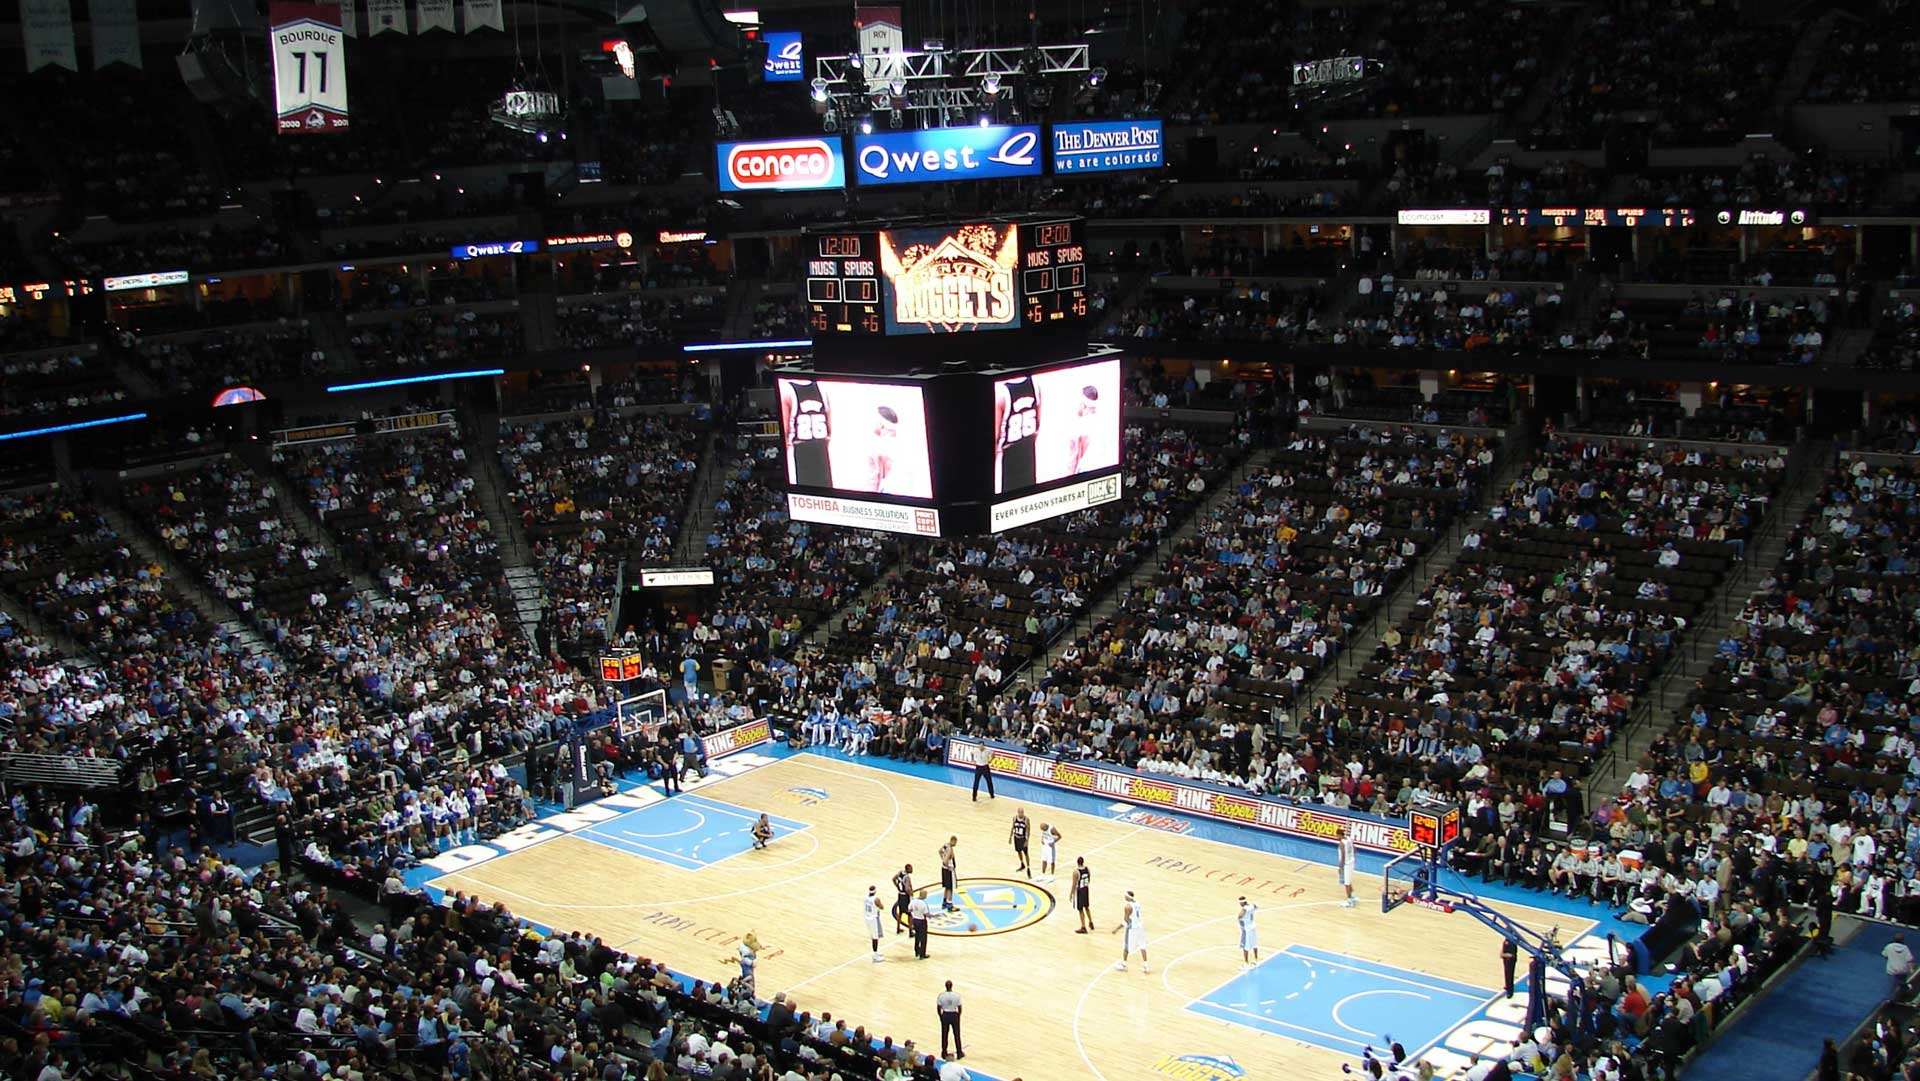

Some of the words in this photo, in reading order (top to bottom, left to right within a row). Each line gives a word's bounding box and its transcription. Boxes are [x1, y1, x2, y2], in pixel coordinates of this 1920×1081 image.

[279, 31, 336, 45] BOURQUE
[873, 31, 887, 39] ROY
[290, 51, 327, 94] 77
[1055, 130, 1081, 150] THE
[1083, 128, 1130, 149] DENVER
[1131, 126, 1159, 145] POST
[1056, 158, 1073, 170] we
[1079, 156, 1099, 169] are
[1105, 151, 1158, 167] colorado
[825, 238, 858, 255] 12:00
[1057, 247, 1082, 263] SPURS
[810, 261, 836, 275] NUGS
[844, 261, 874, 276] SPURS
[1027, 251, 1049, 267] NUGS
[826, 281, 834, 299] 0
[862, 282, 871, 299] 0
[895, 272, 1014, 322] NUGGETS
[791, 496, 840, 512] TOSHIBA
[842, 505, 873, 517] BUSINESS
[874, 508, 909, 521] SOLUTIONS
[995, 508, 1018, 521] EVERY
[1020, 499, 1049, 513] SEASON
[1050, 492, 1076, 506] STARTS
[1077, 490, 1085, 499] AT
[706, 732, 735, 754] KING
[951, 742, 978, 763] KIN
[1022, 757, 1052, 779] KING
[1053, 762, 1092, 786] Soopers
[1096, 772, 1130, 795] KING
[1131, 777, 1172, 803] Soopers
[1176, 787, 1211, 811] KING
[1214, 793, 1256, 819] Soopers
[1260, 804, 1297, 829] KING
[1350, 822, 1389, 847] KING
[1145, 856, 1201, 874] PEPSI
[1205, 870, 1306, 898] CENTER
[643, 911, 696, 931] PEPSI
[693, 927, 785, 960] CENR
